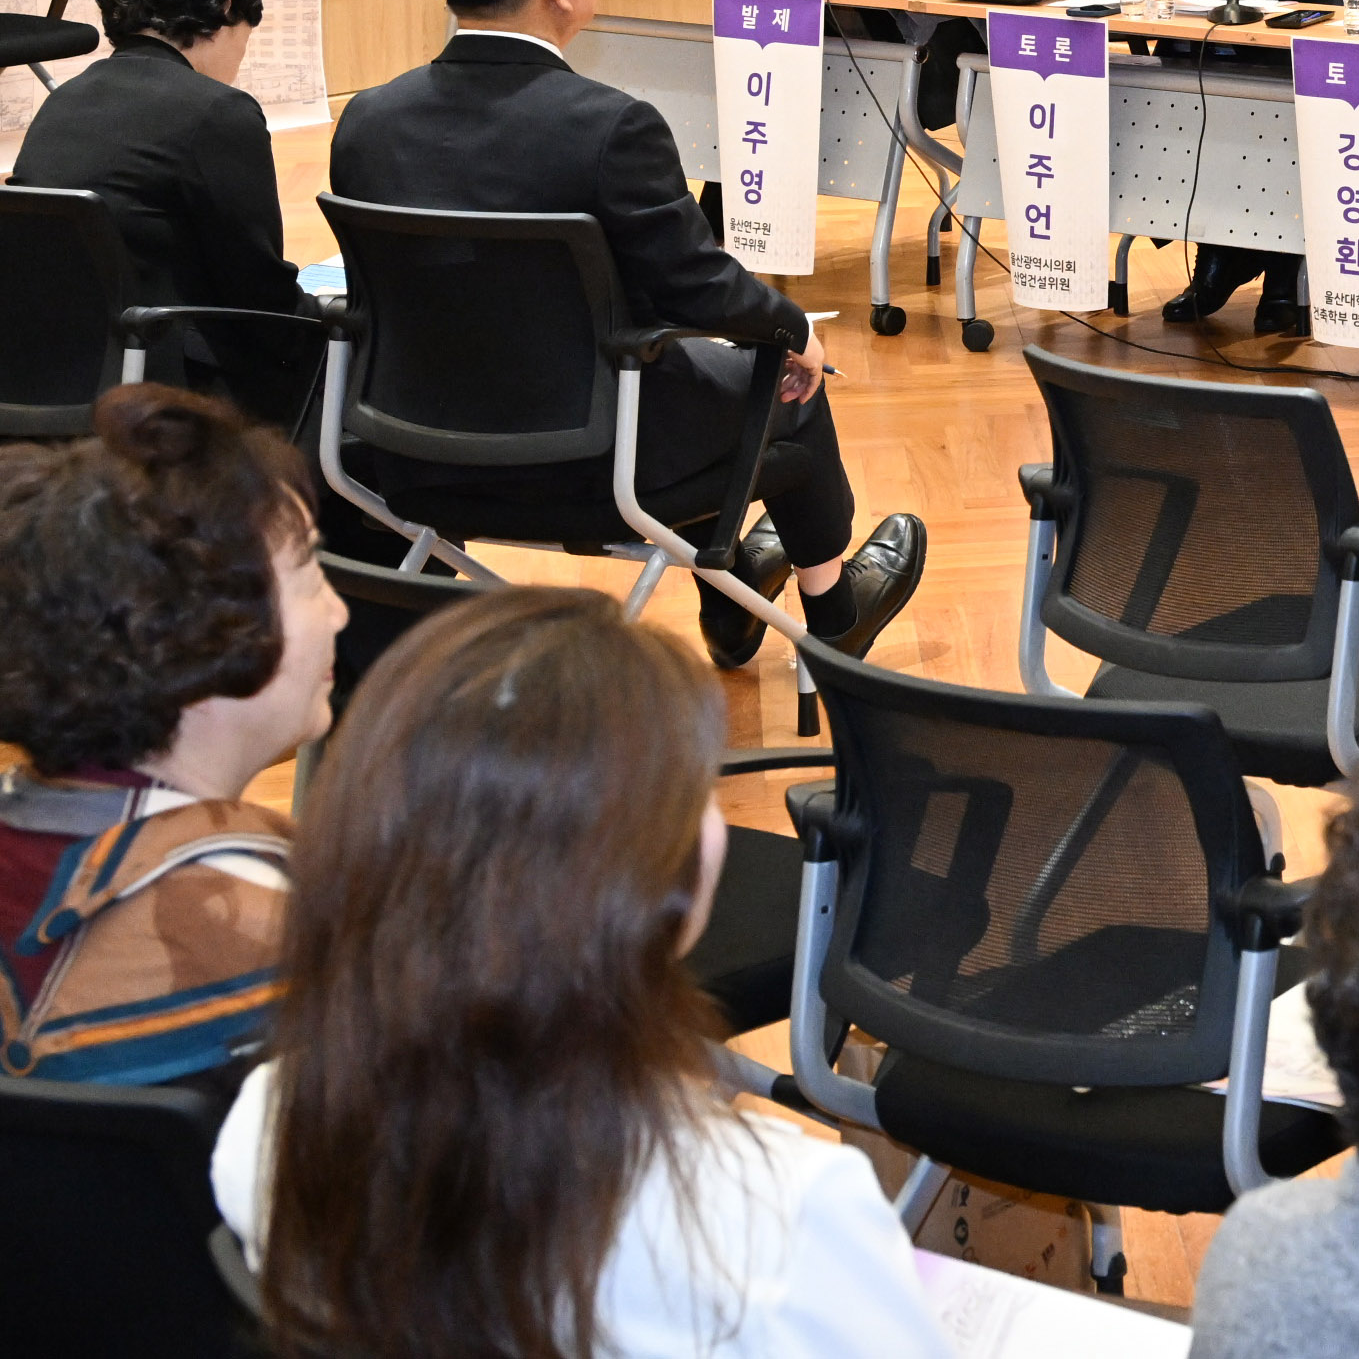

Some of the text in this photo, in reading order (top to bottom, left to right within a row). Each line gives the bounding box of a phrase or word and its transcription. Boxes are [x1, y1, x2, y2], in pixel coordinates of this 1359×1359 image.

[740, 71, 772, 205] 이주영
[1024, 102, 1056, 241] 이주언
[729, 216, 772, 237] 울산연구원
[733, 235, 767, 254] 연구위원
[1010, 251, 1077, 275] 울산광역시의회
[1013, 272, 1071, 292] 산업건설위원
